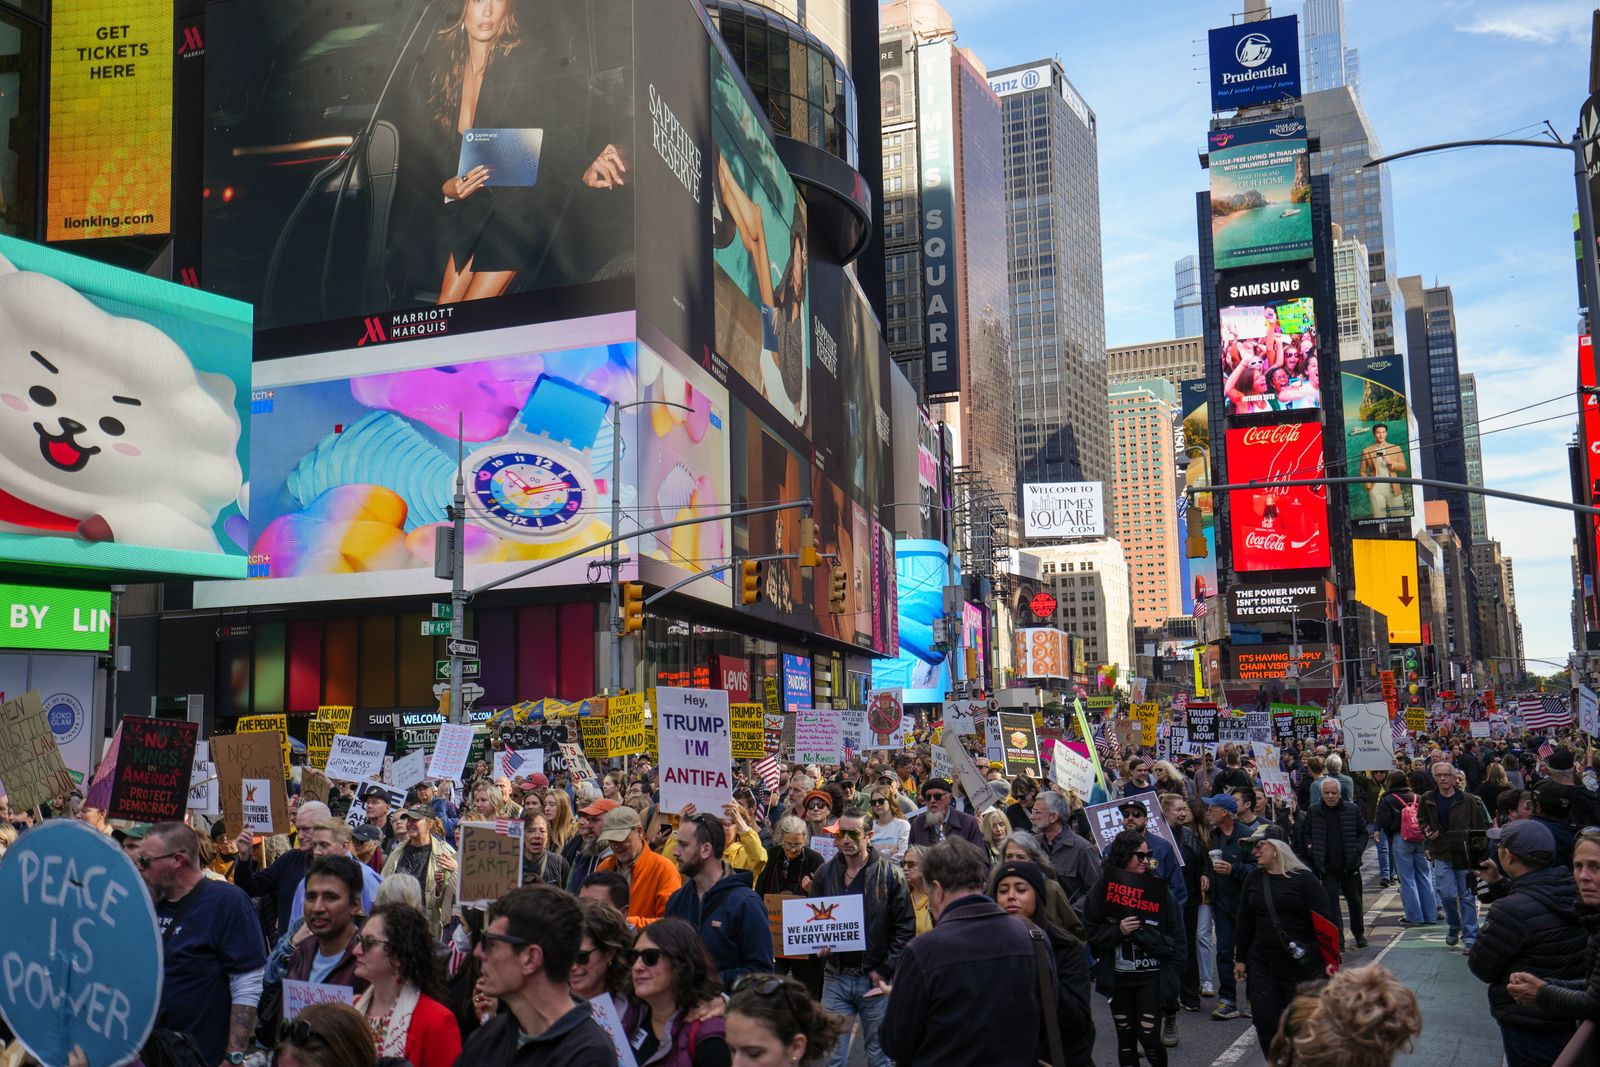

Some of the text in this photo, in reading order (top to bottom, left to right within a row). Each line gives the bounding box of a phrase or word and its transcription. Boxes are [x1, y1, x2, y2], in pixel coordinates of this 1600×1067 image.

[96, 25, 130, 40] GET
[77, 43, 149, 62] TICKETS
[89, 64, 136, 80] HERE
[1222, 63, 1288, 85] Prudential
[921, 57, 943, 188] TIMES
[649, 83, 702, 178] SAPPHIRE
[652, 120, 700, 204] RESERVE
[1210, 156, 1246, 167] HASSLE-FREE
[1247, 154, 1268, 163] LIVING
[1276, 148, 1306, 158] THAILAND
[1224, 157, 1293, 172] WITH UNLIMITED ENTRIES
[1233, 176, 1286, 190] YOUR HOME
[64, 212, 154, 229] lionking.com
[924, 208, 949, 373] SQUARE
[1229, 278, 1300, 298] SAMSUNG
[392, 308, 454, 325] MARRIOTT
[392, 321, 447, 338] MARQUIS
[1243, 424, 1302, 446] Coca-Cola
[491, 460, 504, 468] 10
[535, 456, 554, 470] 12
[1029, 486, 1079, 494] WELCOME
[1055, 498, 1094, 510] TIMES
[1245, 533, 1287, 551] Coca-Cola
[1236, 587, 1316, 598] THE POWER MOVE
[1236, 597, 1293, 607] ISN'T DIRECT
[10, 604, 49, 629] BY
[1237, 605, 1300, 615] EYE CONTACT.
[436, 624, 444, 634] 45
[451, 643, 461, 652] ONE
[1239, 653, 1288, 662] IT'S HAVING
[1240, 662, 1266, 671] CHAIN
[1240, 671, 1286, 680] WITH FEDE
[683, 694, 707, 708] Hey,
[320, 708, 350, 719] WE WON
[403, 713, 447, 725] WELCOME
[610, 712, 643, 727] NOTHING
[731, 706, 763, 718] TRUMP &
[1188, 709, 1217, 718] TRUMP
[1246, 713, 1269, 721] DEFEND
[51, 718, 72, 726] GLAM
[239, 718, 285, 731] THE PEOPLE
[609, 722, 642, 733] WITHOUT
[663, 713, 727, 736] TRUMP,
[986, 719, 998, 727] NO
[583, 726, 606, 736] DEMAND
[731, 732, 746, 740] GUILTY
[1357, 731, 1378, 739] Believe
[144, 732, 168, 749] NO
[308, 732, 333, 747] UNITE
[337, 737, 364, 749] YOUNG
[585, 737, 607, 748] ICE OUT
[609, 733, 644, 751] DEMAND
[731, 740, 763, 752] GENOCIDE!
[228, 743, 253, 763] NO
[684, 739, 709, 757] I'M
[132, 750, 180, 767] KINGS
[330, 757, 372, 769] GROWN ASS
[147, 764, 157, 772] IN
[240, 762, 281, 779] KINGS
[342, 766, 368, 776] NAZIS
[122, 765, 178, 787] AMERICA
[664, 767, 729, 788] ANTIFA
[129, 785, 174, 802] PROTECT
[118, 798, 179, 816] DEMOCRACY
[465, 855, 520, 877] EARTH
[18, 848, 129, 928] PEACE
[1107, 881, 1144, 898] FIGHT
[1106, 890, 1160, 913] FASCISM
[787, 921, 860, 934] WE HAVE FRIENDS
[48, 916, 97, 974] IS
[787, 930, 860, 945] EVERYWHERE
[3, 951, 131, 1041] POWER
